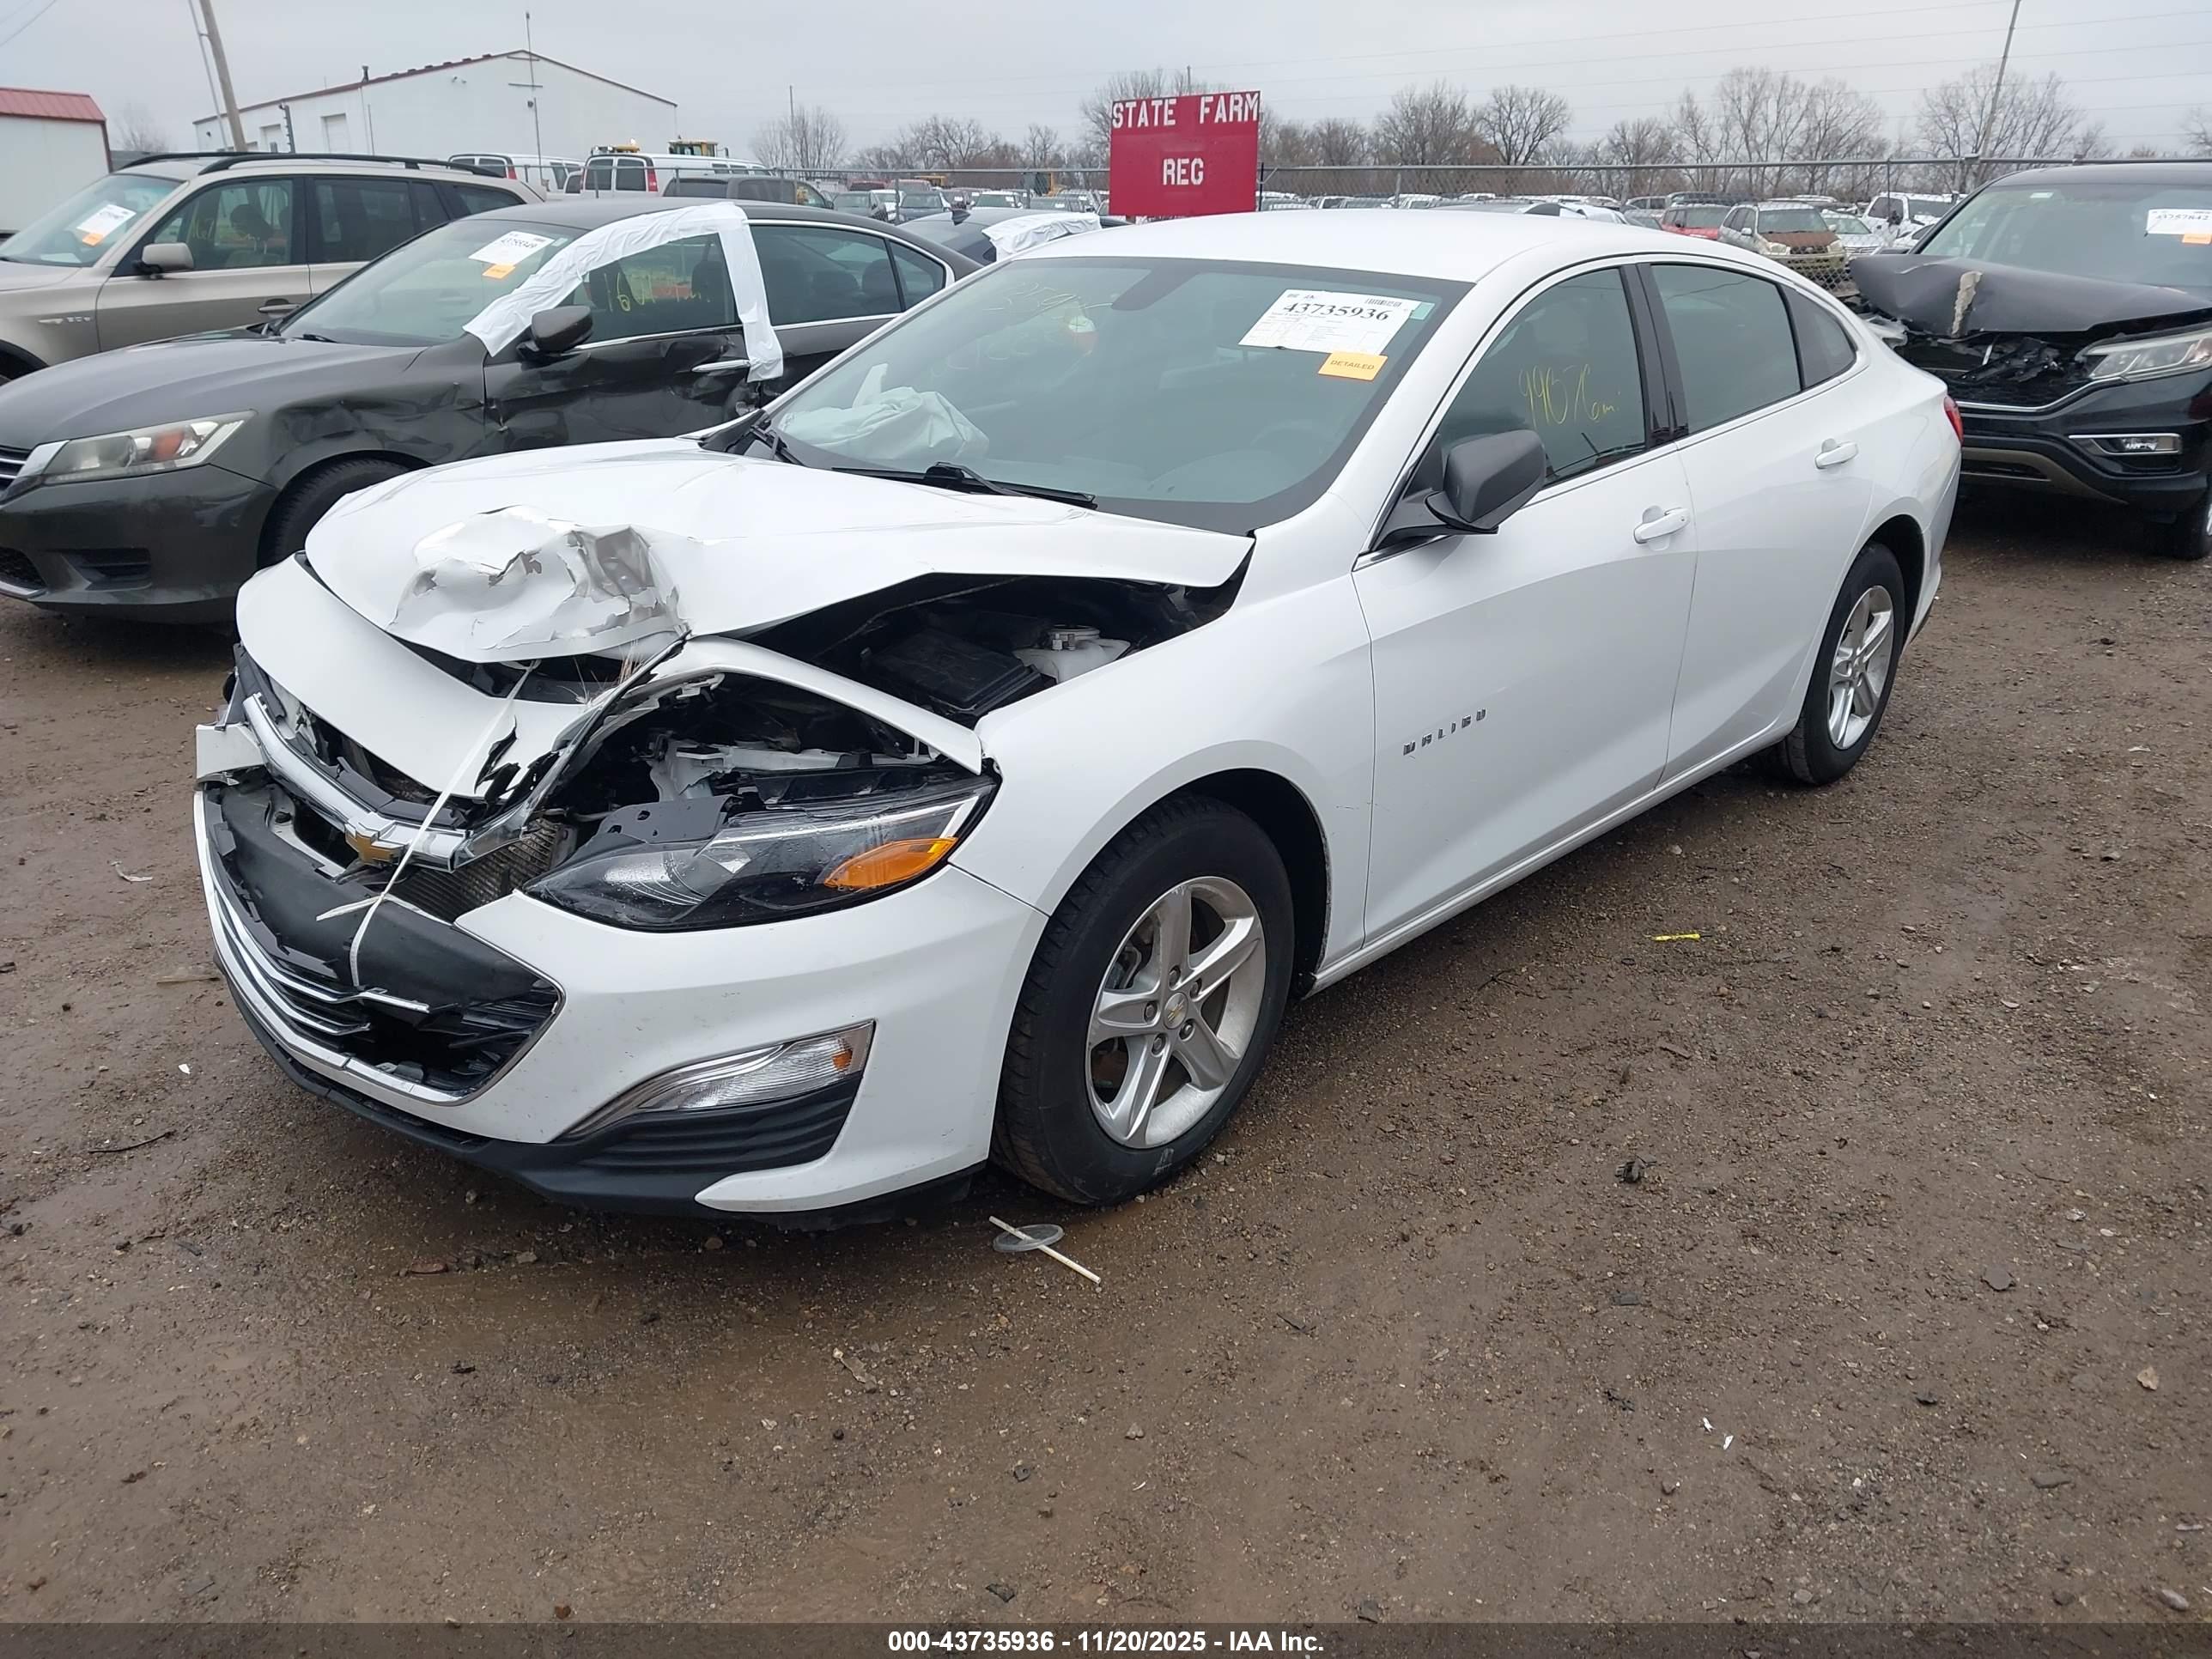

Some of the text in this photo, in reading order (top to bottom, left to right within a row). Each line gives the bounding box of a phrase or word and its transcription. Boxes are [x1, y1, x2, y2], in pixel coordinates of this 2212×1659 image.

[1112, 92, 1260, 129] STATE FARM
[1162, 157, 1204, 186] REG
[1282, 301, 1394, 322] 43735936
[1329, 359, 1376, 371] DETAILED
[1402, 707, 1487, 757] MALIBU
